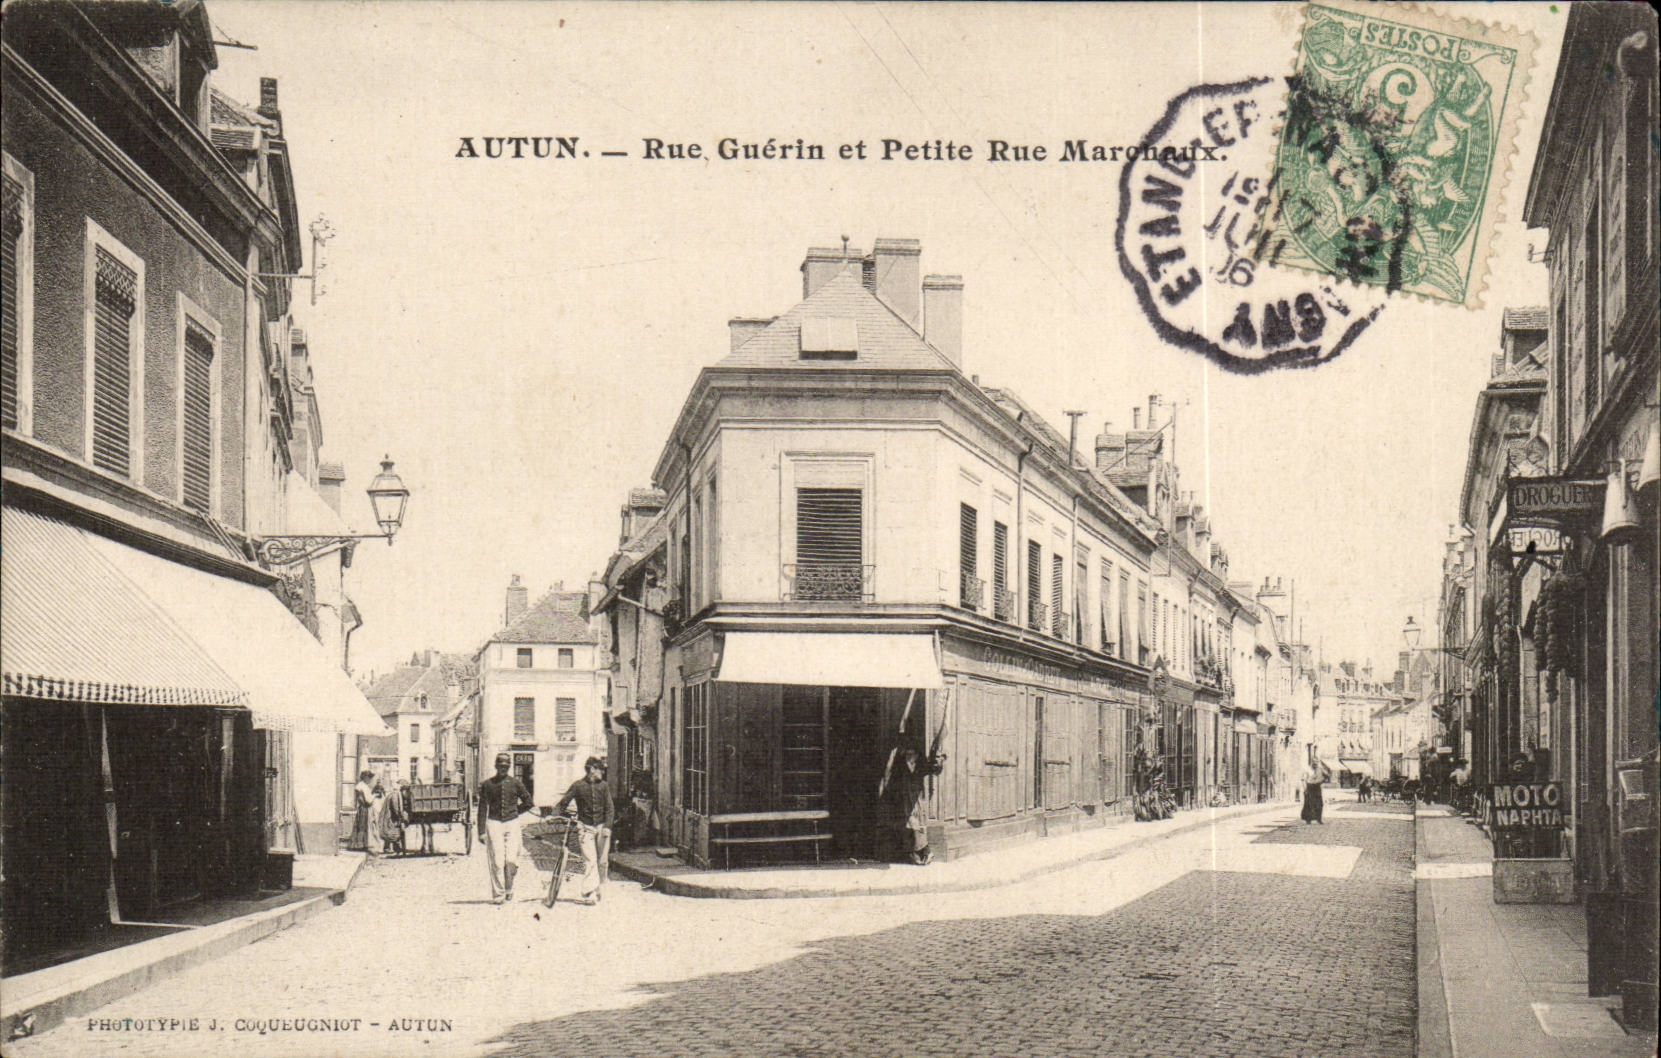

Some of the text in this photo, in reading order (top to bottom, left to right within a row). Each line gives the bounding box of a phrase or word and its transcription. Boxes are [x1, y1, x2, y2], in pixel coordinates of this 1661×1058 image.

[1364, 21, 1459, 62] POSTES
[1494, 783, 1559, 807] MOTO
[1496, 808, 1562, 826] NAPHTA
